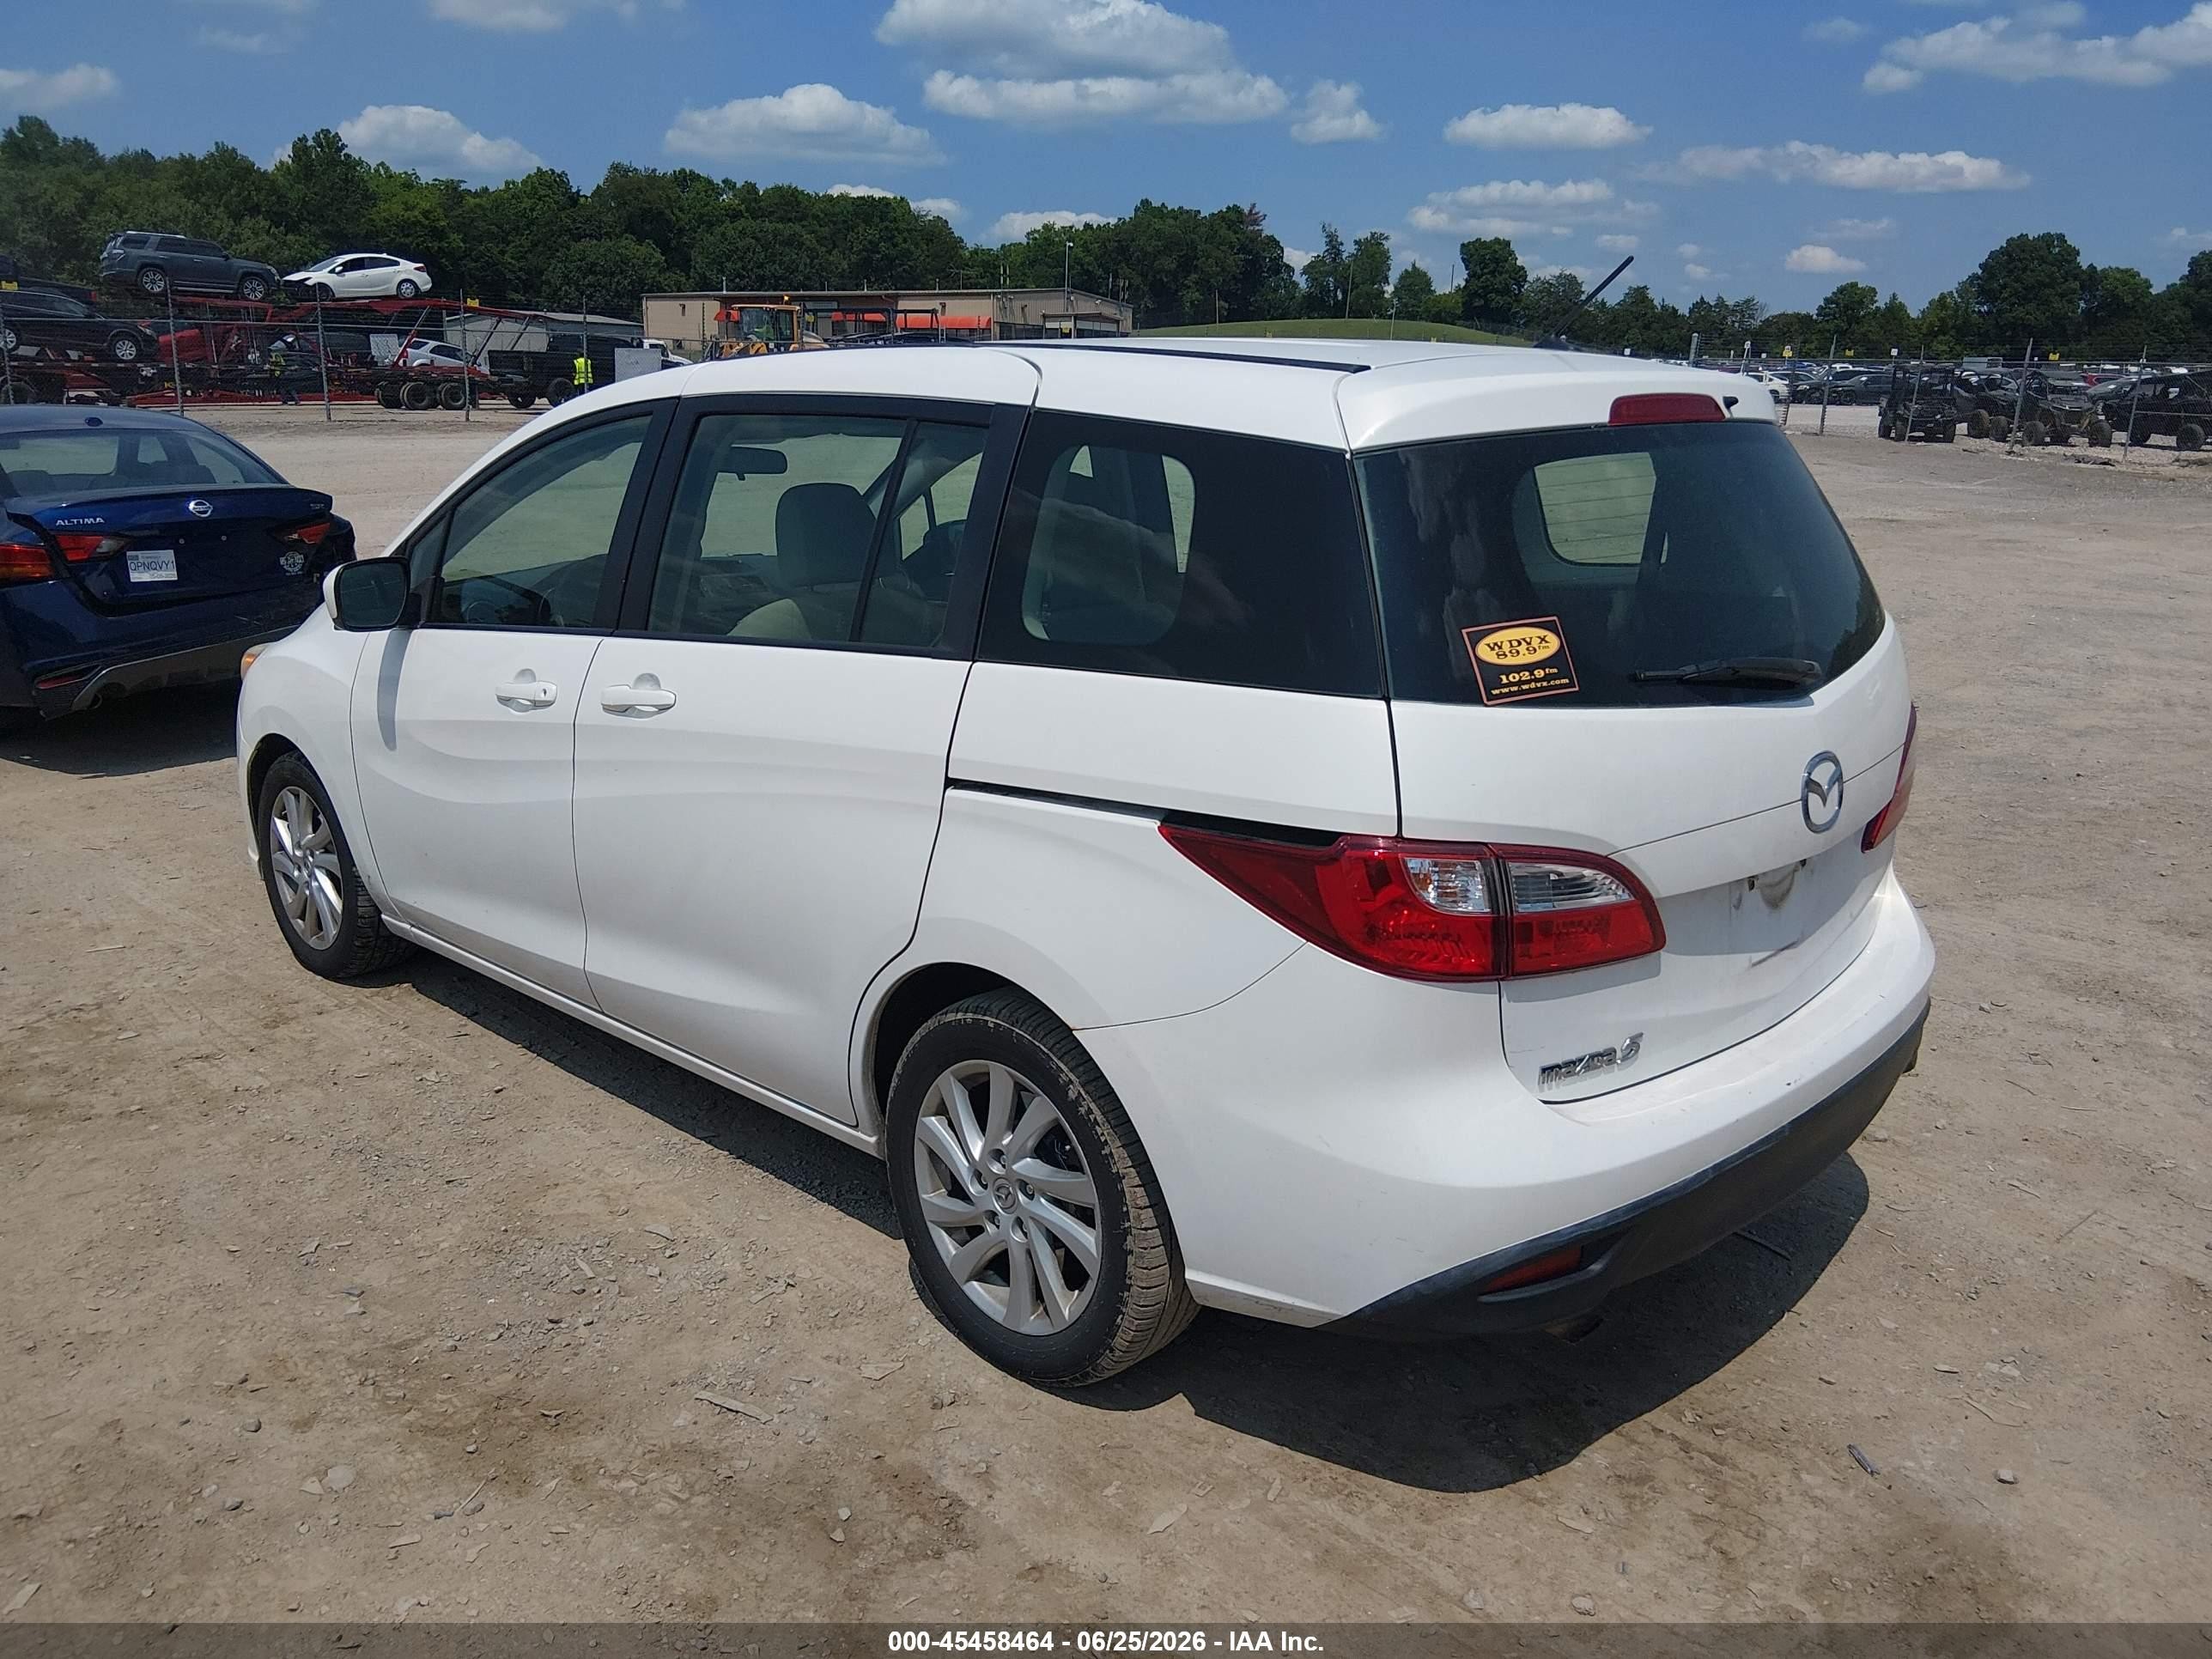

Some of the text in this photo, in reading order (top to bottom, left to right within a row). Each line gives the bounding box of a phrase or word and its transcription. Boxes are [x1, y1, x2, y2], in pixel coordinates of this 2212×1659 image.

[56, 517, 105, 526] ALTIMA
[1485, 635, 1551, 652] WDVX
[1491, 678, 1570, 695] www.wdvx.com
